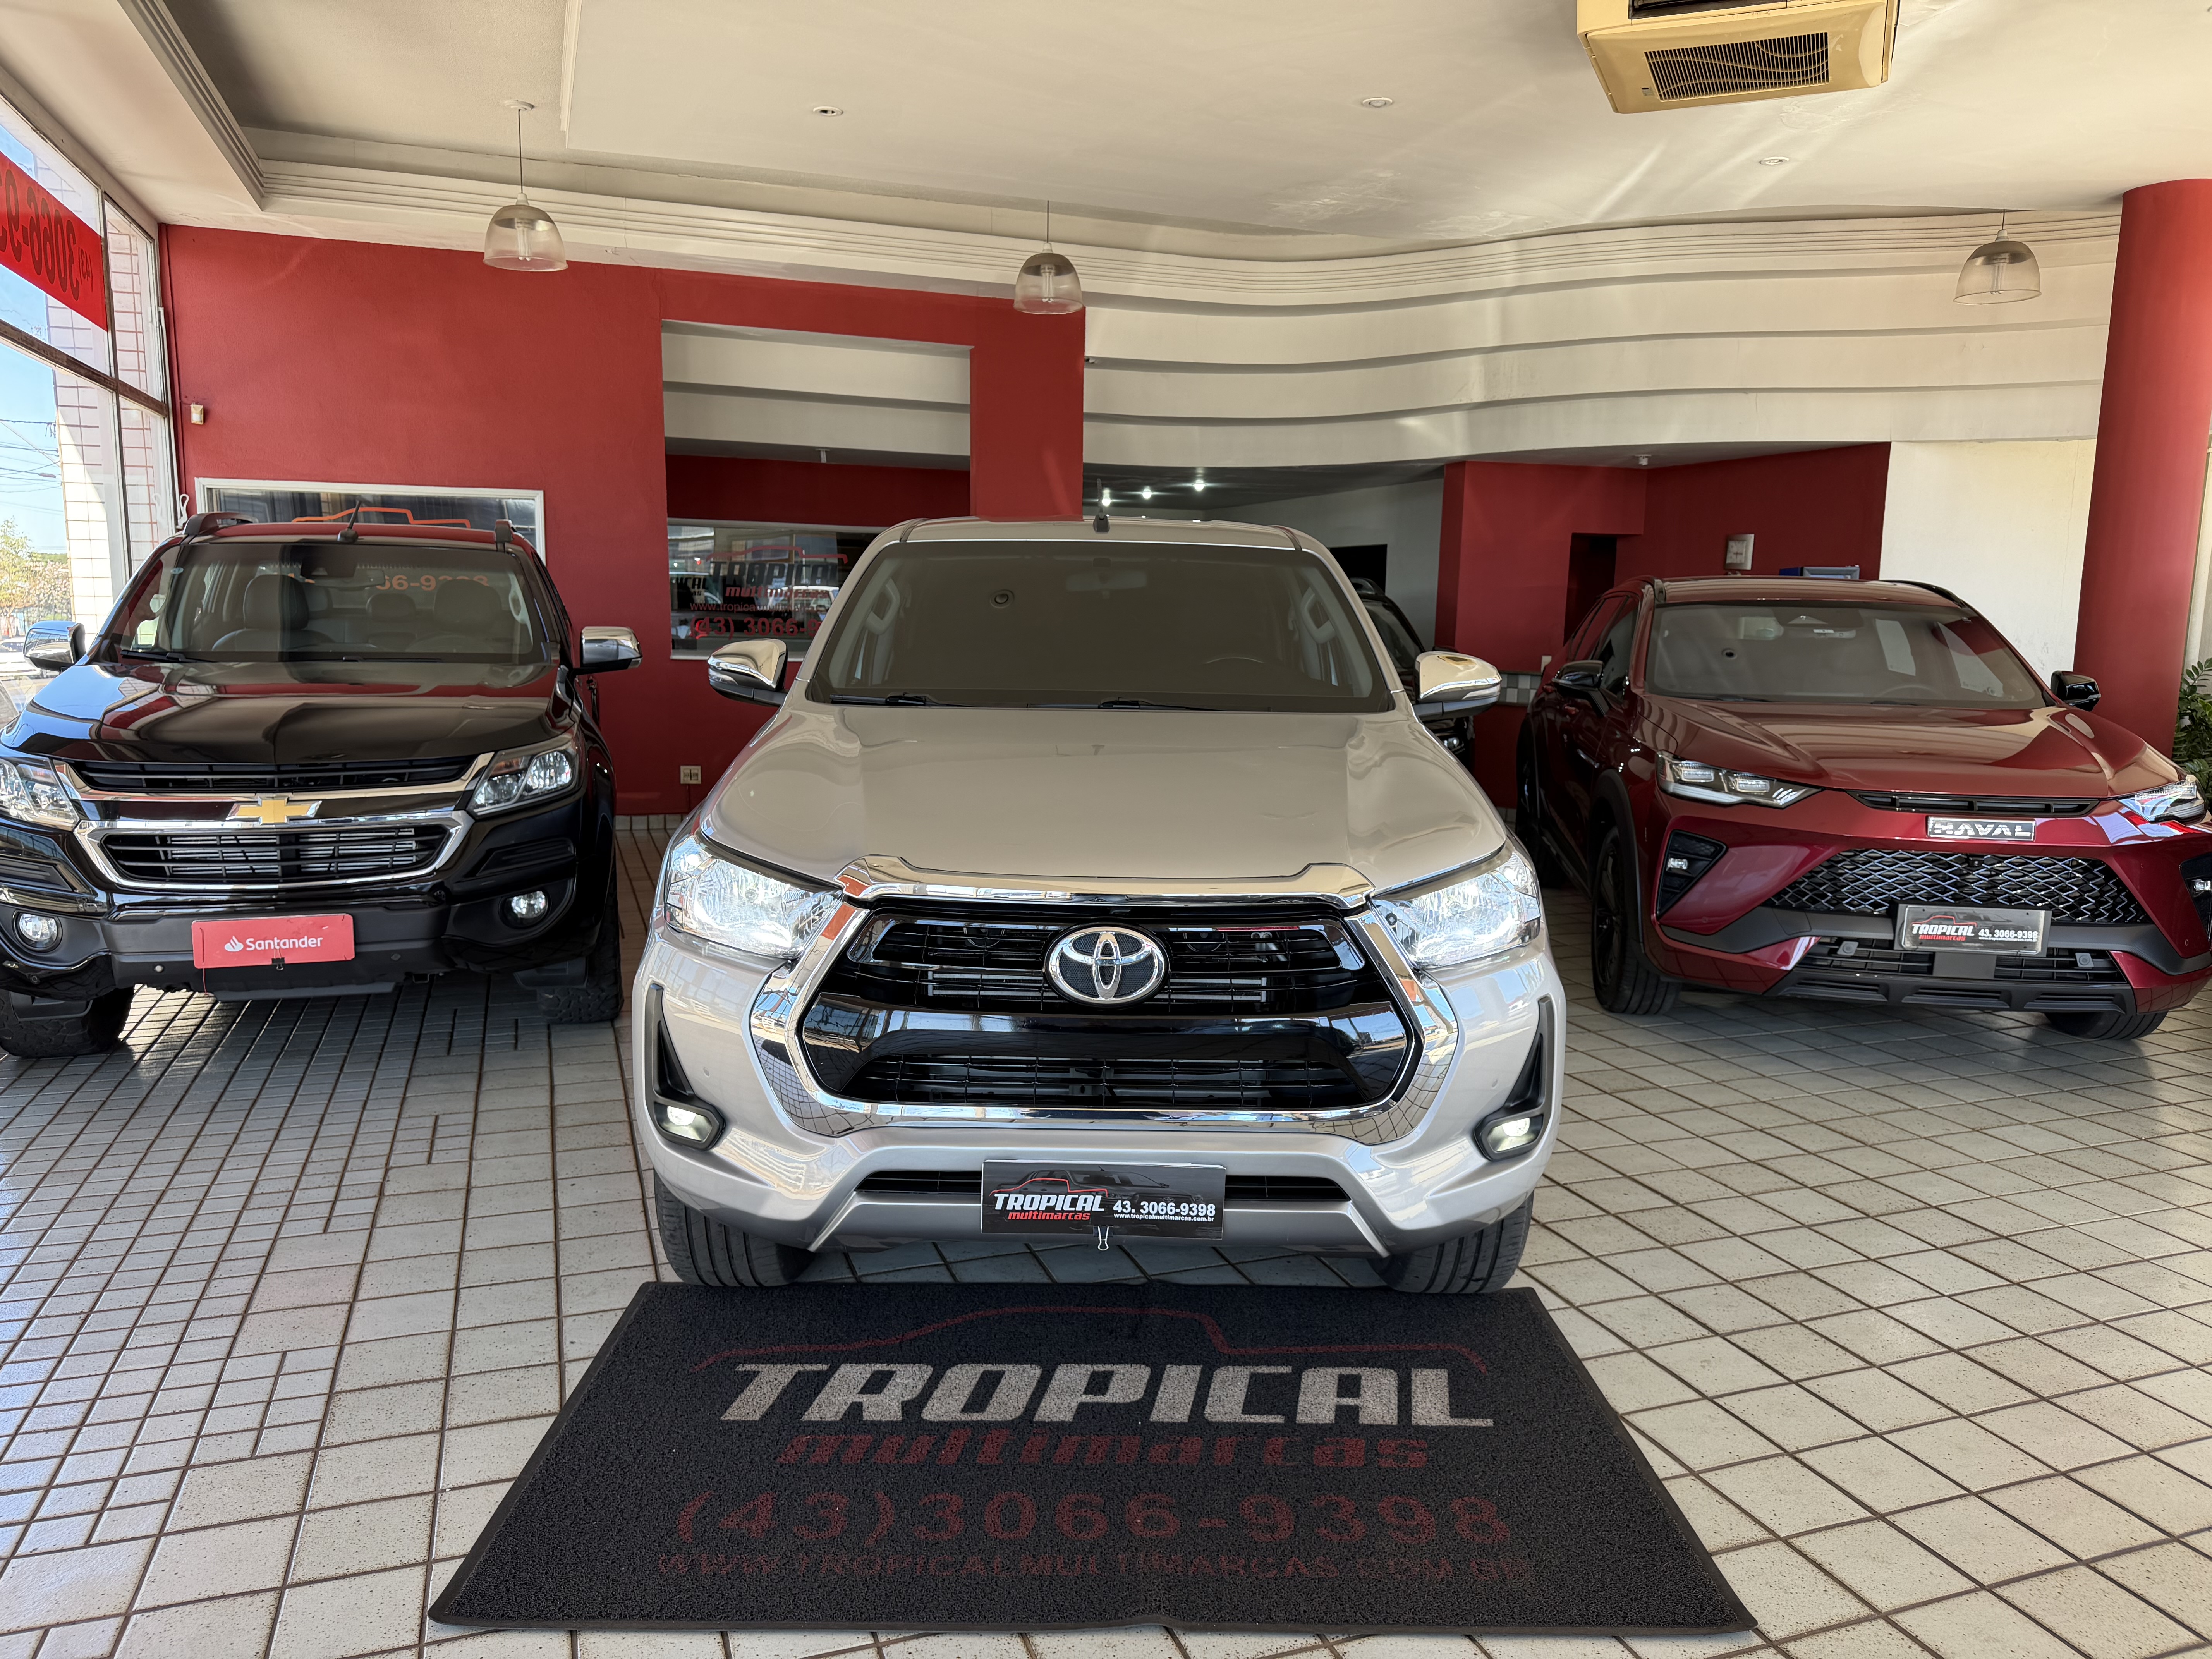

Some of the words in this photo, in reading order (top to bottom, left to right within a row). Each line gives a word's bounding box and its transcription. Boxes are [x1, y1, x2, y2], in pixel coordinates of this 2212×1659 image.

[710, 561, 839, 587] TROPICAL
[690, 616, 735, 640] (43)
[743, 617, 821, 637] 3066-9
[1934, 822, 2032, 837] HAVAL
[1911, 924, 1975, 936] TROPICAL
[1994, 929, 2039, 939] 3066-9398
[246, 935, 323, 951] Santander
[994, 1194, 1104, 1211] TROPICAL
[1113, 1200, 1136, 1214] 43.
[1140, 1201, 1216, 1217] 3066-9398
[1007, 1210, 1091, 1221] multimarcas
[1113, 1212, 1215, 1222] www.tropicalmultimarcas.com.br
[720, 1363, 1494, 1427] TROPICAL
[776, 1427, 1429, 1470] multimarcas
